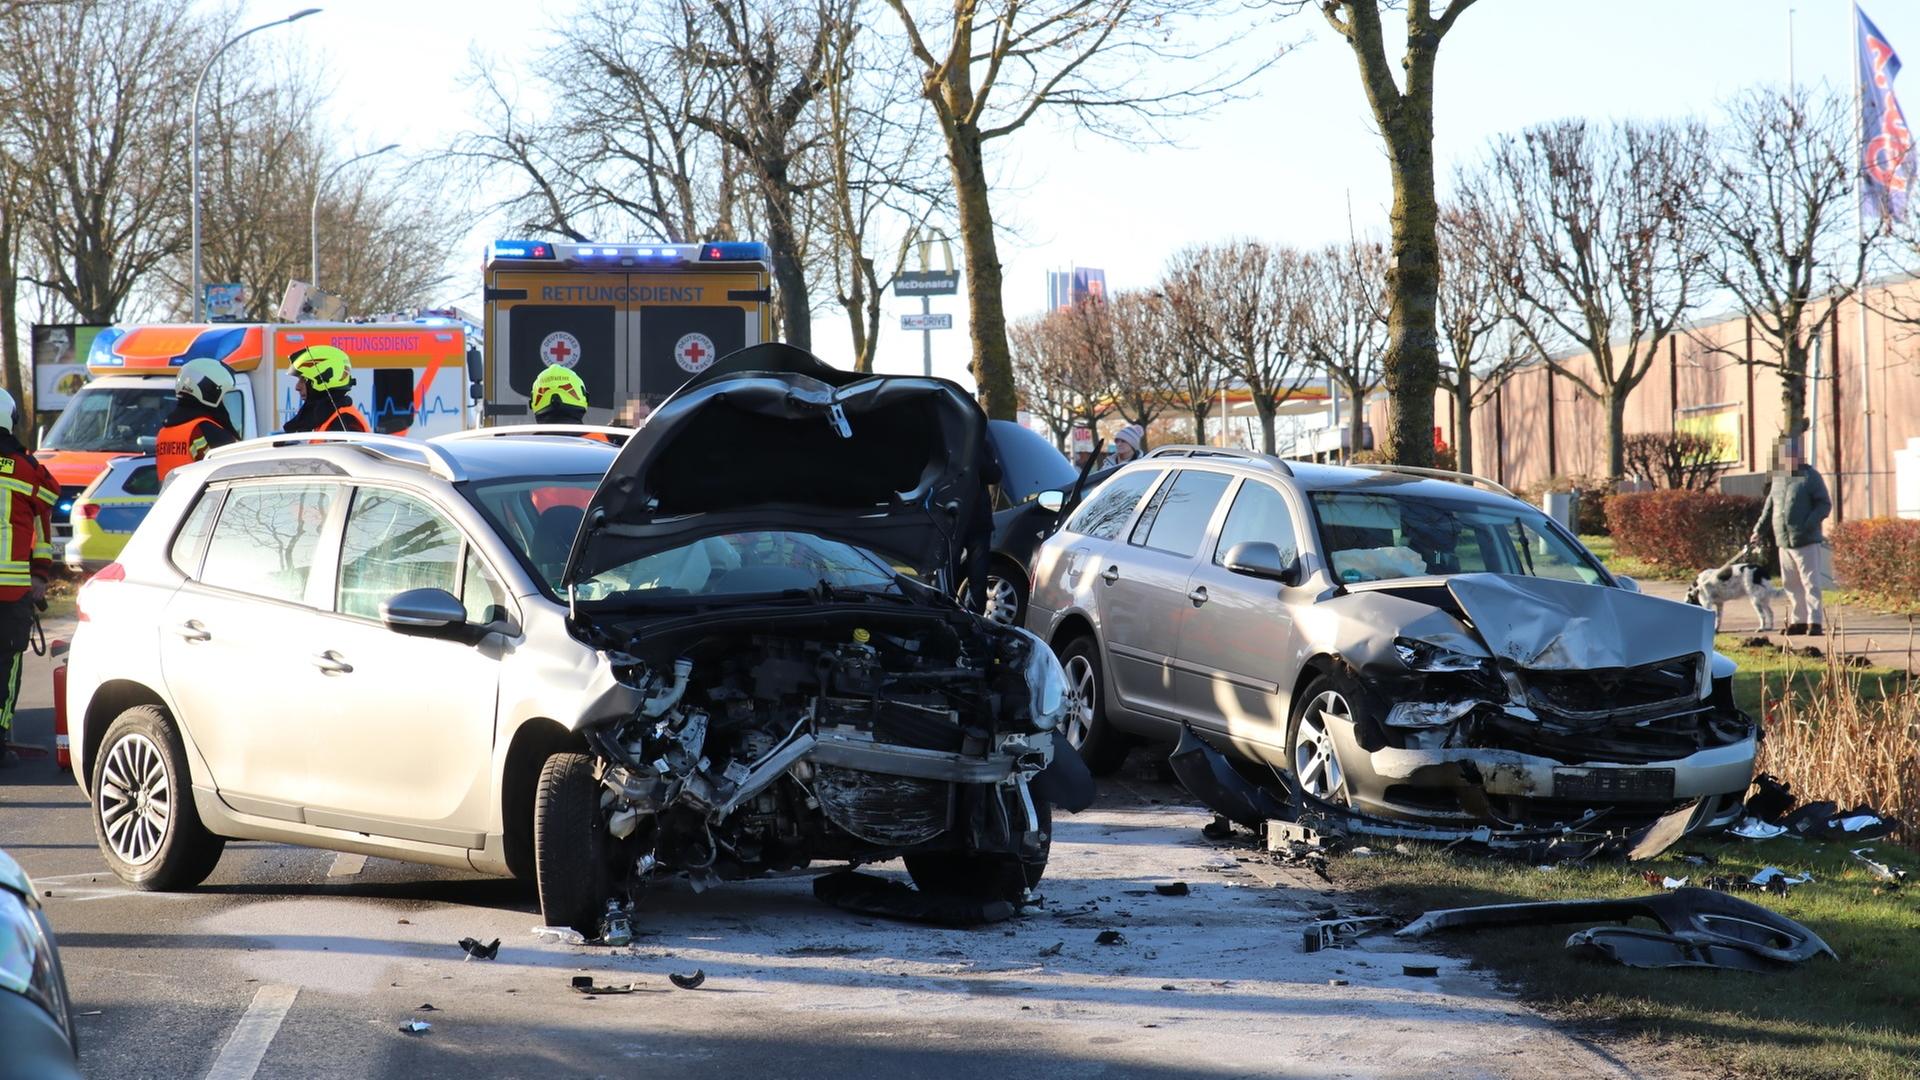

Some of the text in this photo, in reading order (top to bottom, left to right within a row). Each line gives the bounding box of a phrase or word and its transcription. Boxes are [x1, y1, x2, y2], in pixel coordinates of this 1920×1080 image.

[897, 280, 955, 289] McDonald's
[543, 286, 704, 302] RETTUNGSDIENST
[331, 336, 419, 351] RETTUNGSDIENST
[157, 441, 188, 456] ERWEHR
